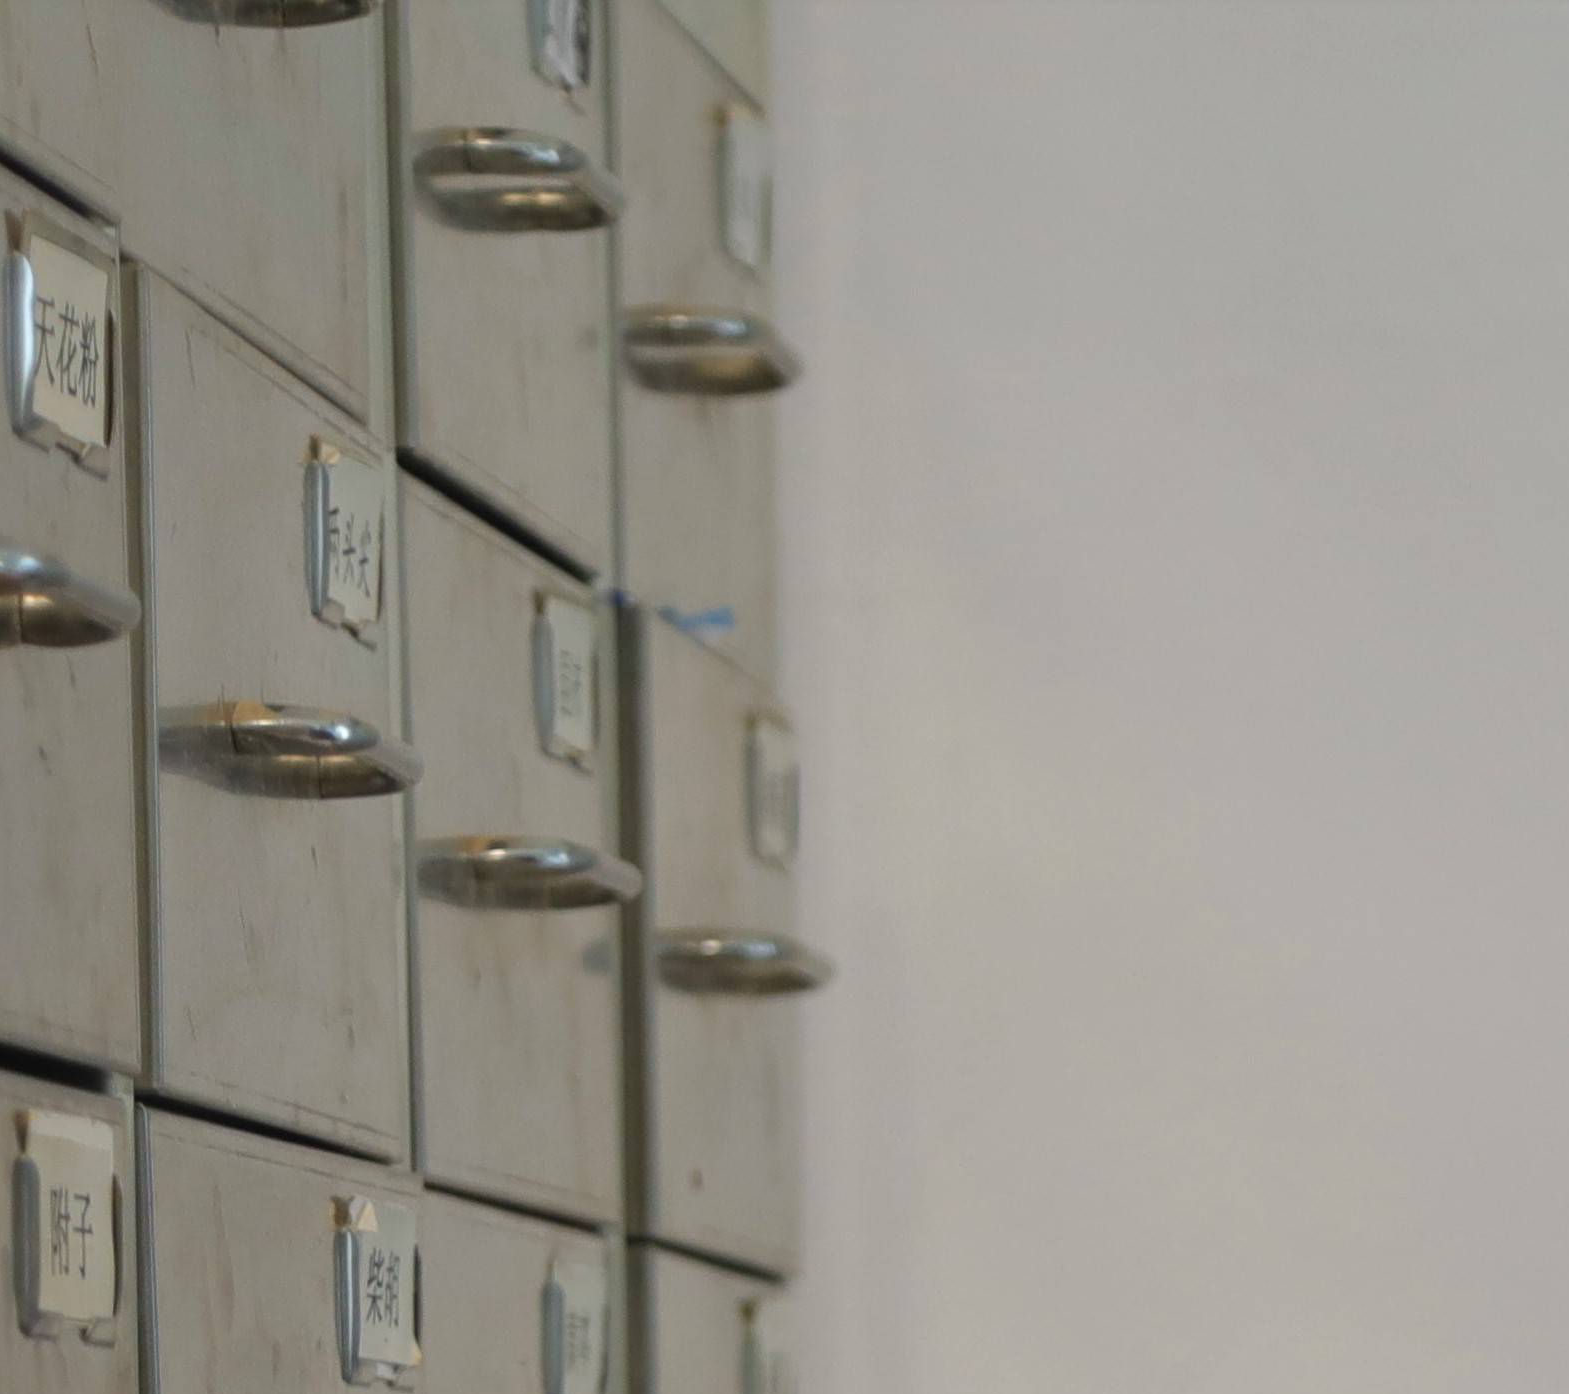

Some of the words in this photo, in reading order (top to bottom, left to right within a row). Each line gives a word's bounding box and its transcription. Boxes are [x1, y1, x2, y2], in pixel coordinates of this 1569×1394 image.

[33, 296, 99, 408] 天花粉
[50, 1185, 94, 1279] 附子
[366, 1247, 401, 1328] 柴胡
